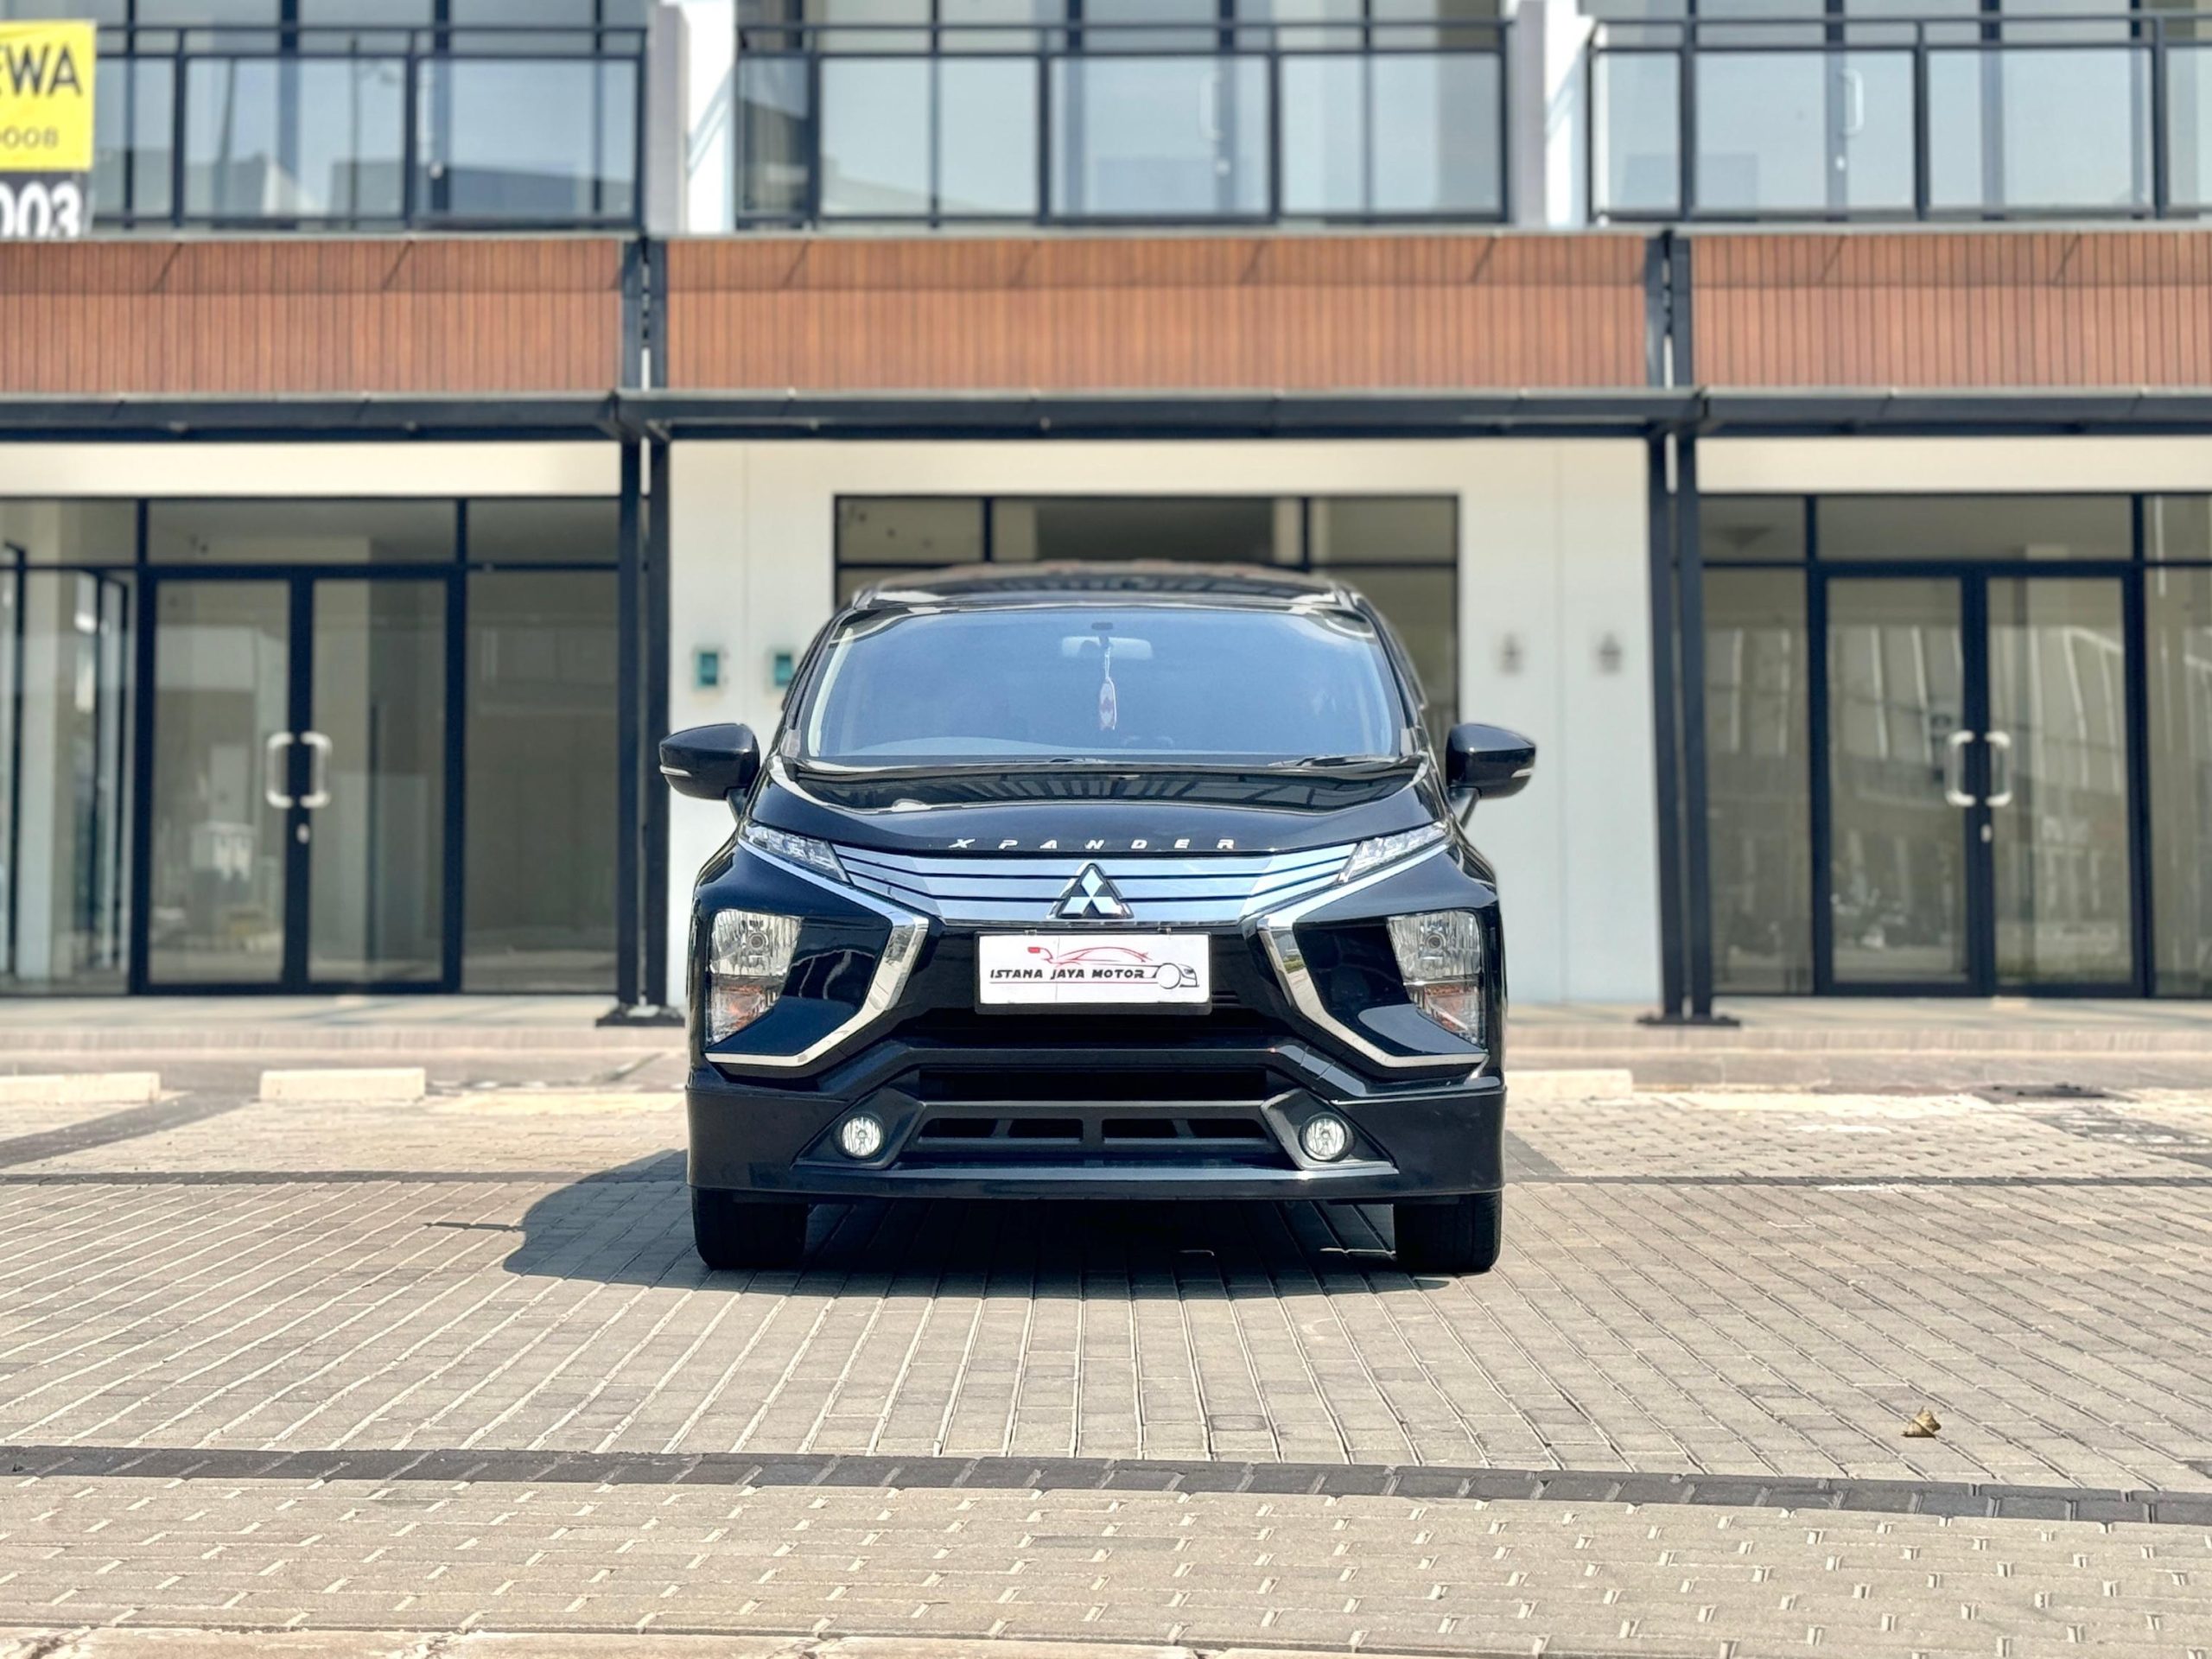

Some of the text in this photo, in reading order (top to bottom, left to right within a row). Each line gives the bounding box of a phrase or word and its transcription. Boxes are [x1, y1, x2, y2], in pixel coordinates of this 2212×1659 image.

[0, 43, 83, 97] WA
[948, 838, 1236, 850] XPANDER
[989, 969, 1145, 980] ISTANA JAYA MOTOR
